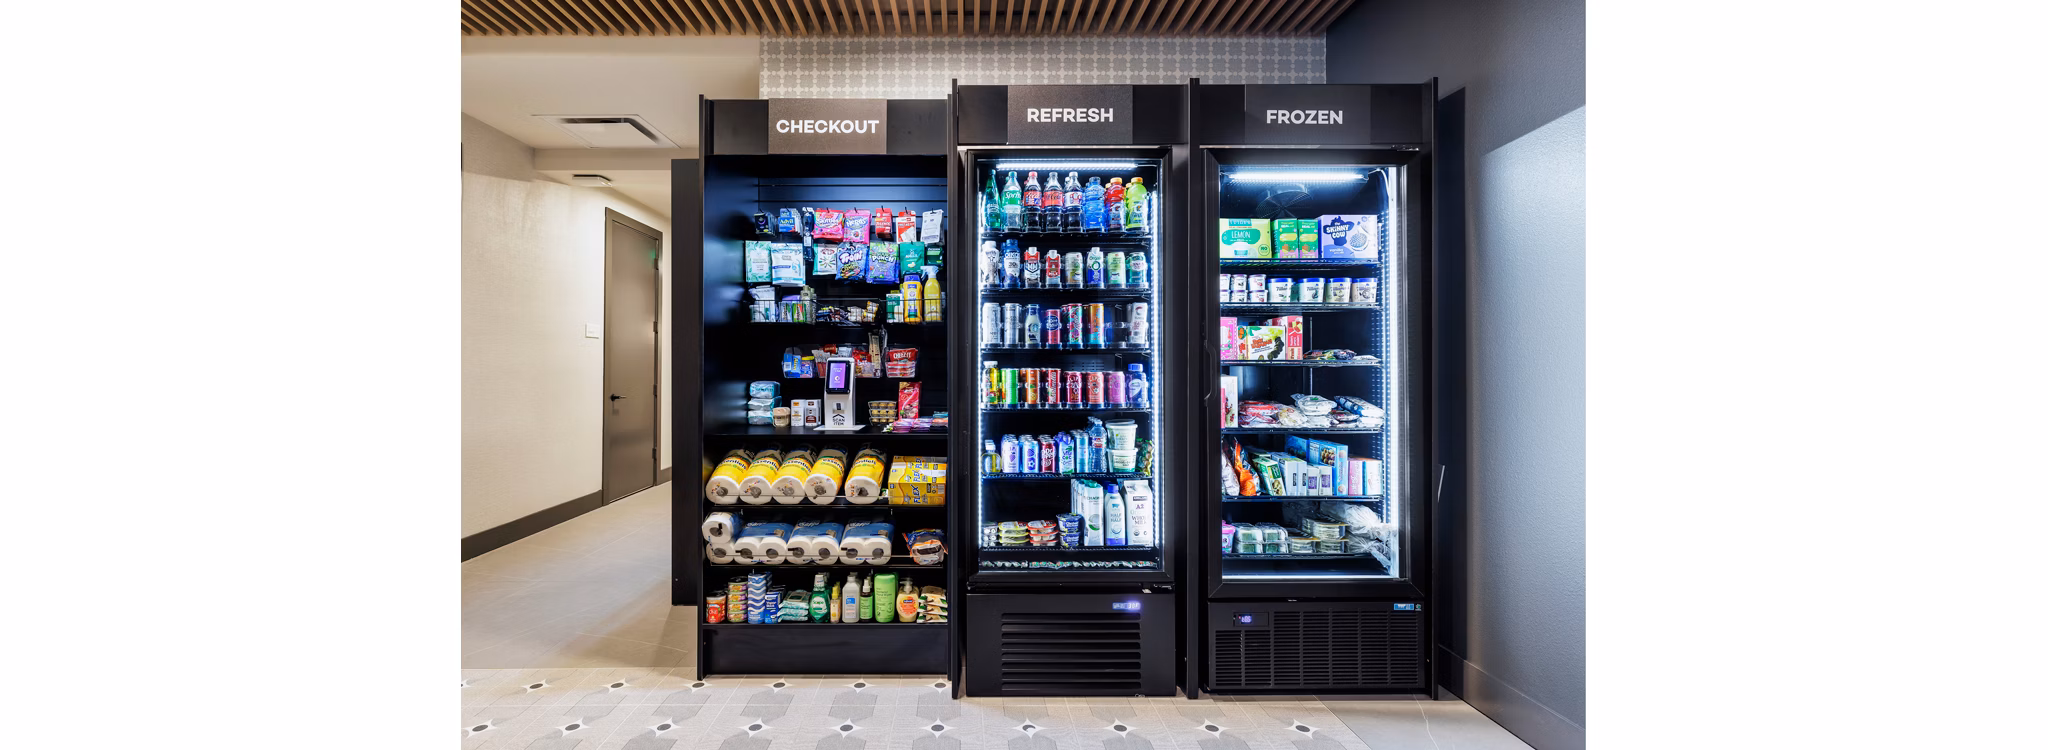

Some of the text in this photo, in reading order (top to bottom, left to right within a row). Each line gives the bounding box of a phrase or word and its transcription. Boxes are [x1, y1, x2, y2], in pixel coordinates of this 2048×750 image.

[1027, 108, 1114, 123] REFRESH
[1266, 109, 1343, 125] FROZEN
[776, 119, 880, 134] CHECKOUT
[1231, 230, 1251, 239] LEMON
[1326, 224, 1349, 234] SKINNY
[1332, 231, 1346, 239] COW
